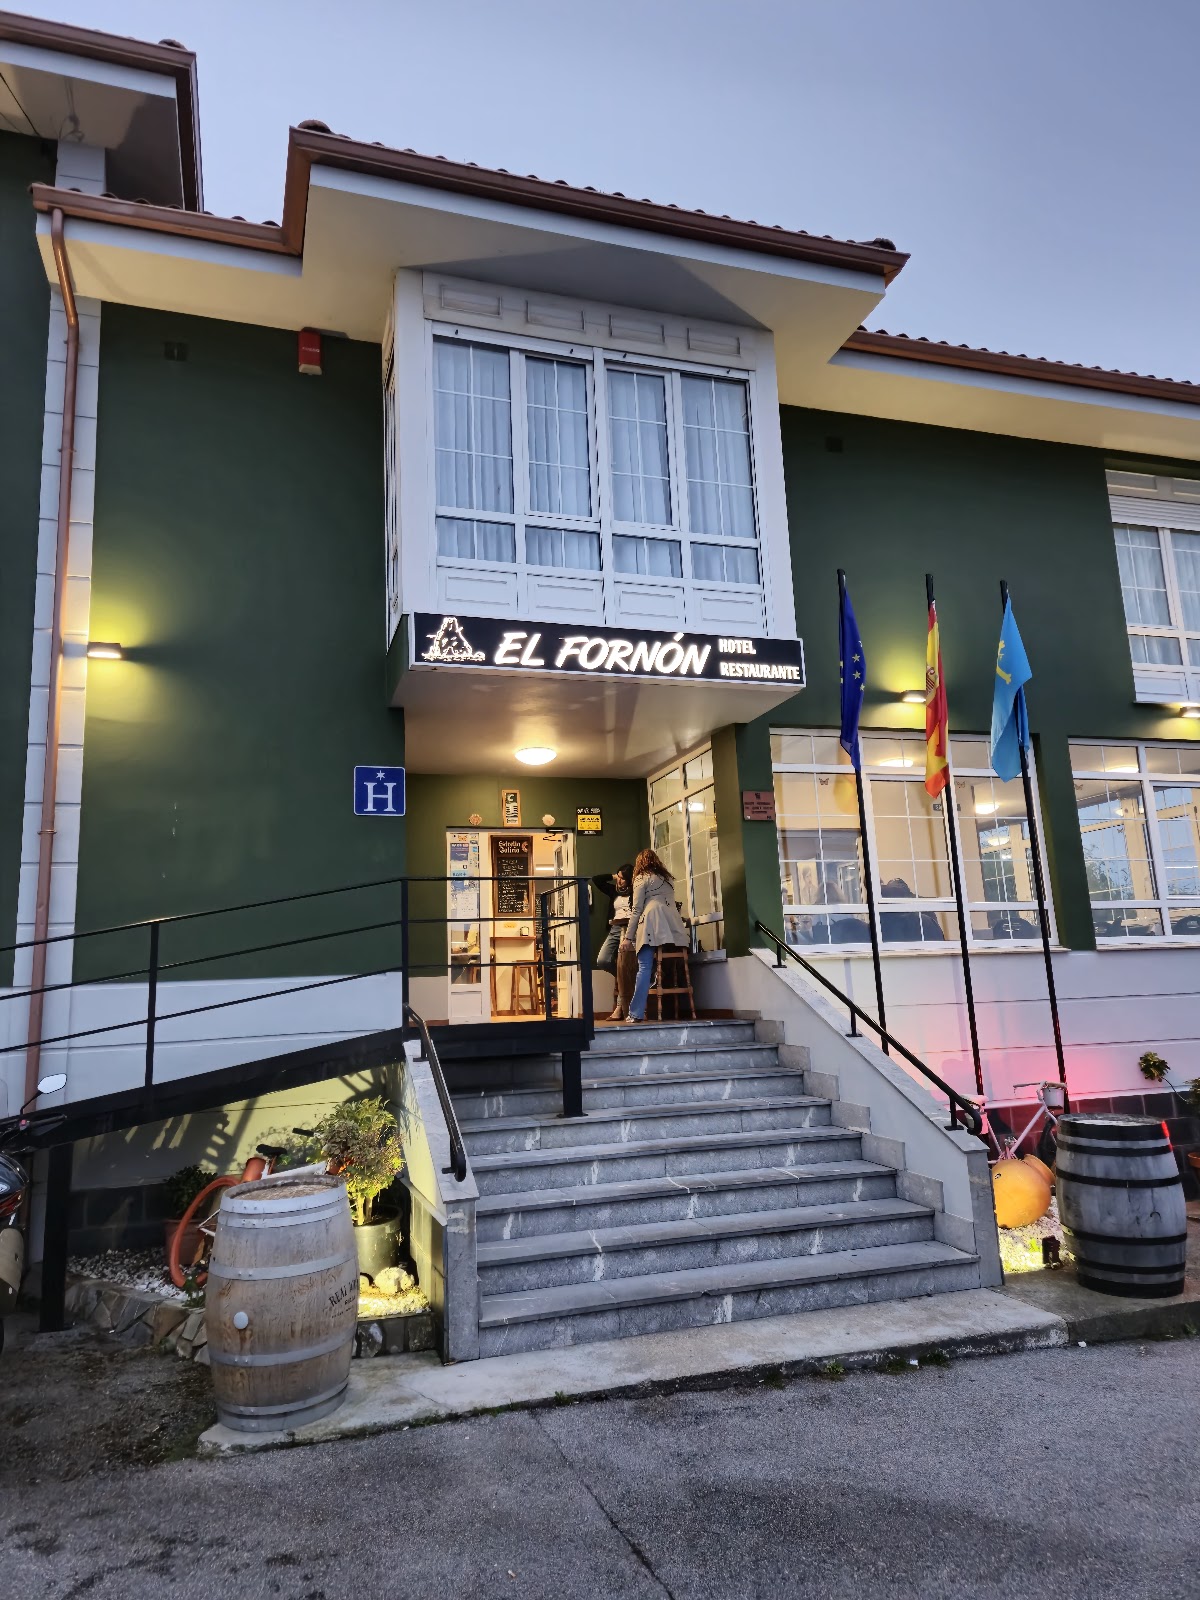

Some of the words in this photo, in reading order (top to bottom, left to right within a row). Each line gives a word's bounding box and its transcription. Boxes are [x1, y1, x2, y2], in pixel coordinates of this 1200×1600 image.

[494, 632, 544, 666] EL
[555, 632, 711, 675] FORNÓN
[718, 638, 757, 655] HOTEL
[720, 661, 801, 680] RESTAURANTE
[363, 781, 397, 812] H
